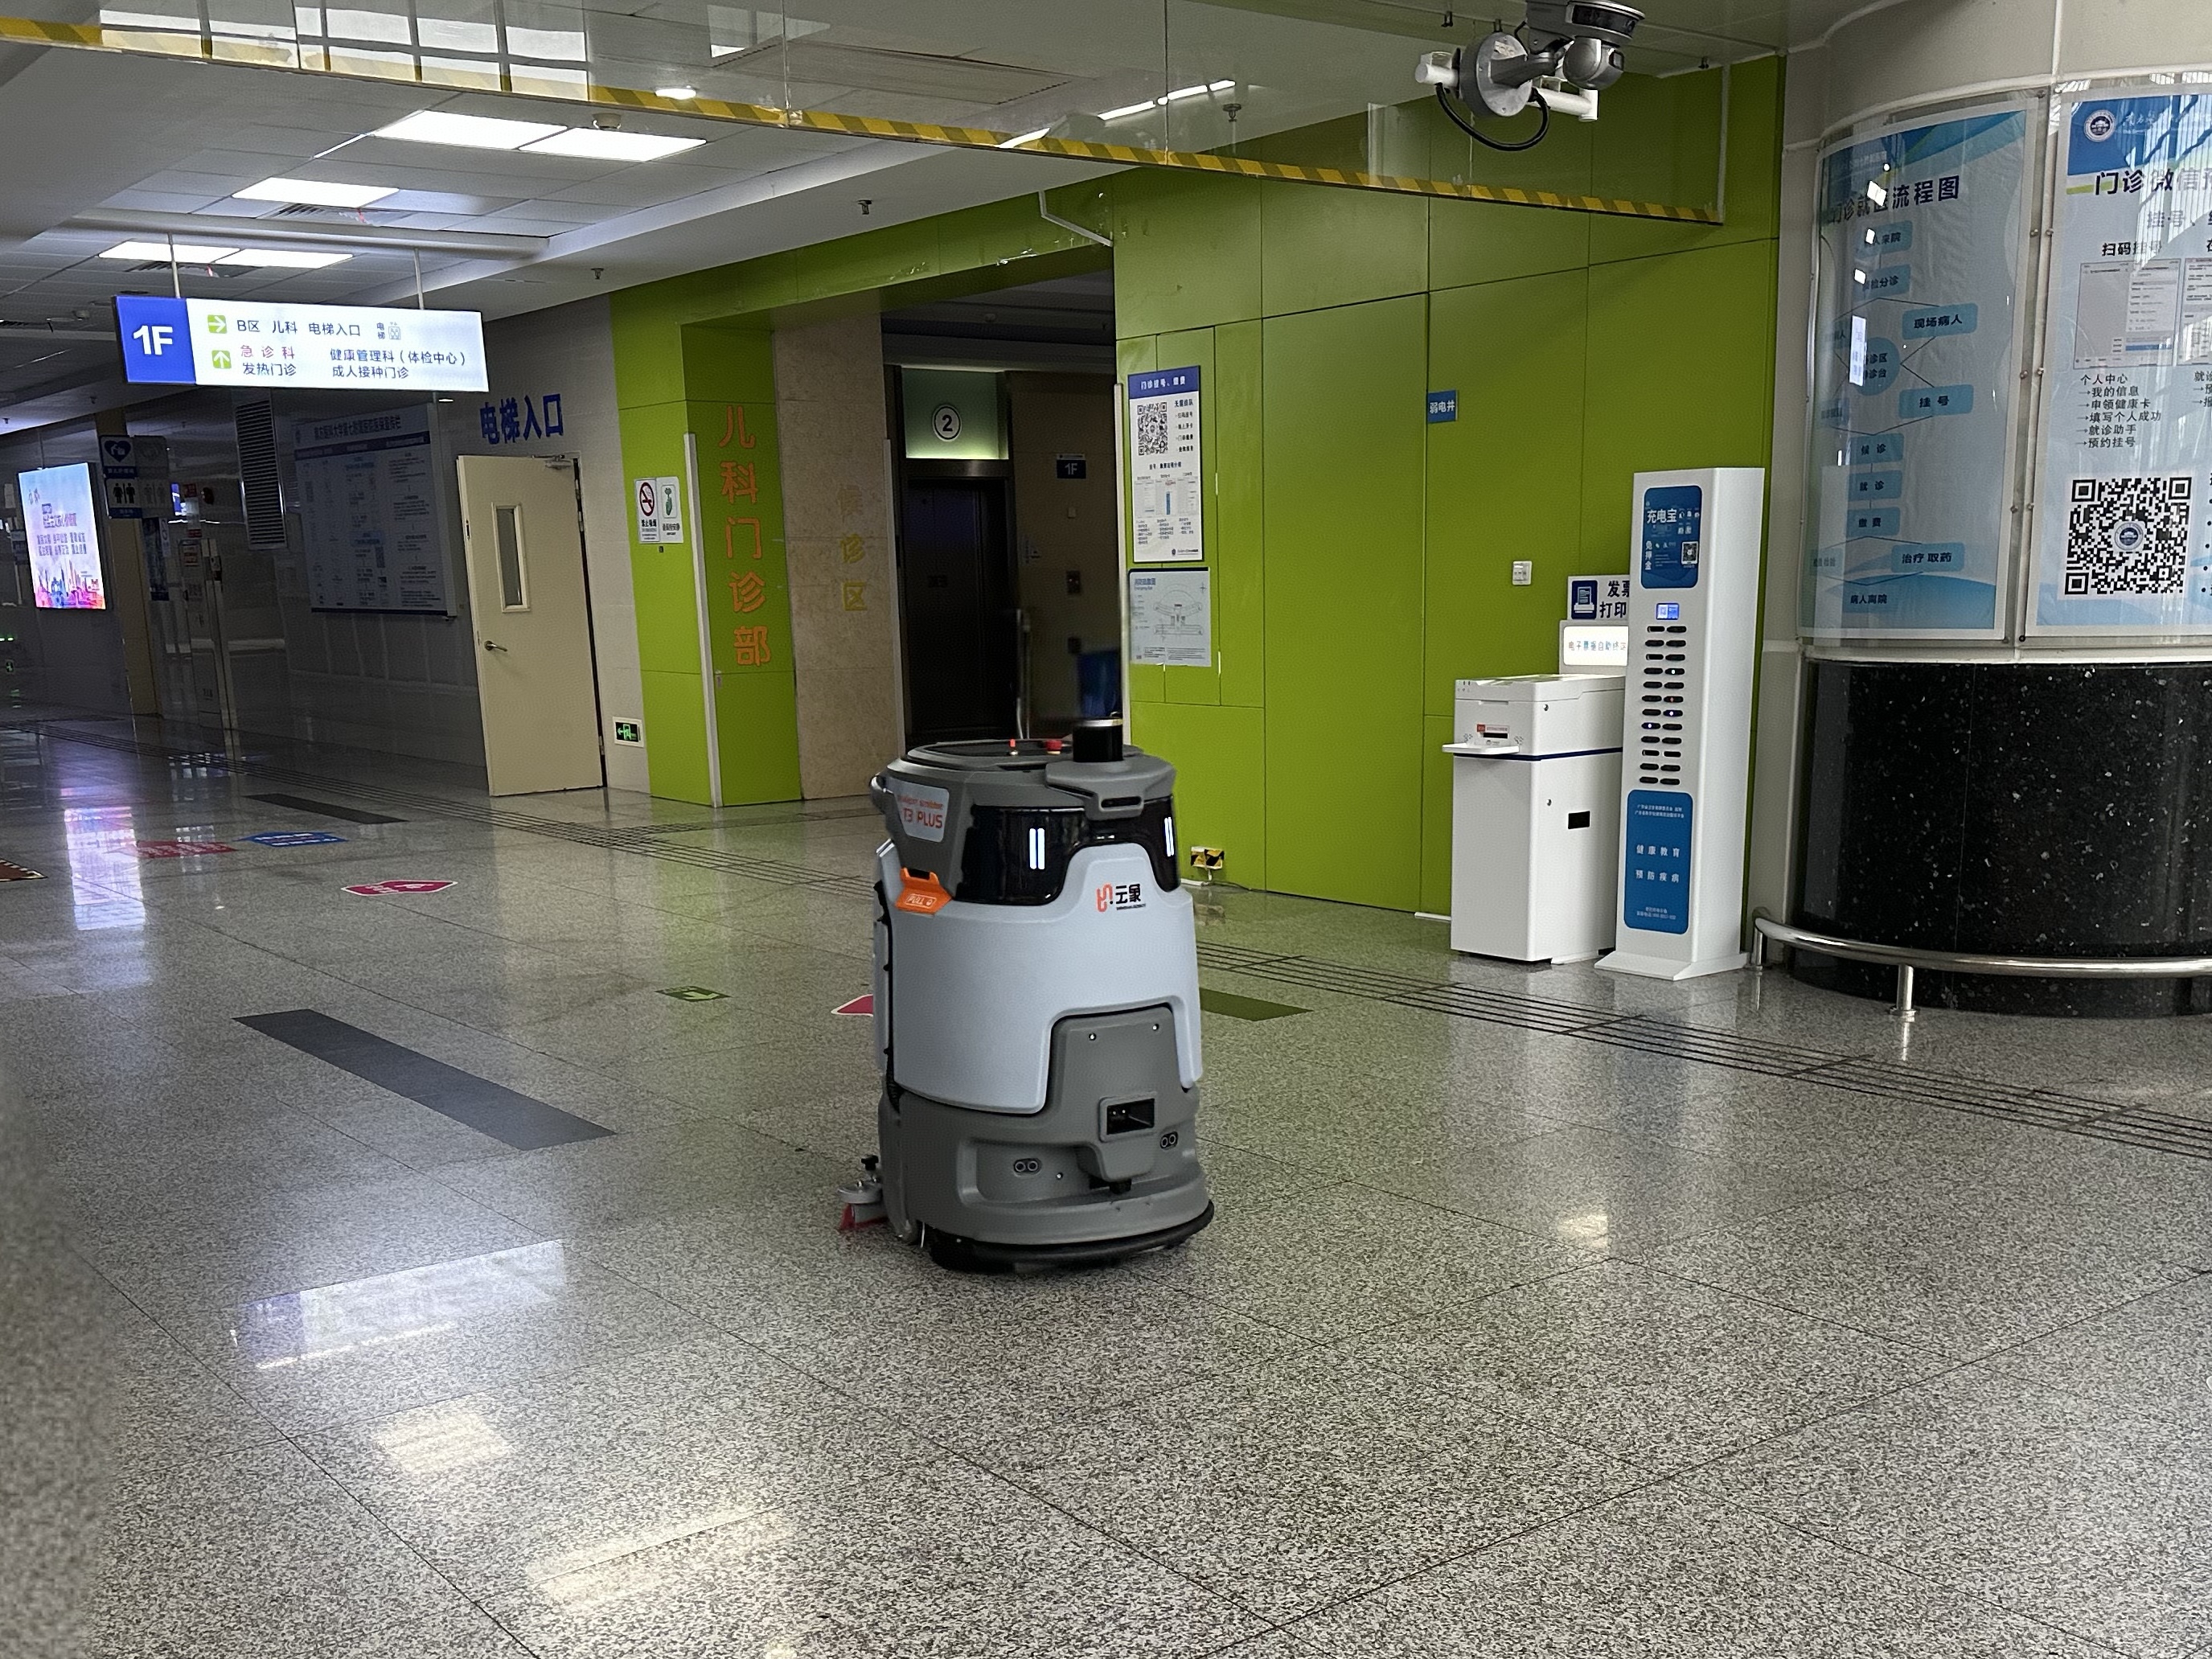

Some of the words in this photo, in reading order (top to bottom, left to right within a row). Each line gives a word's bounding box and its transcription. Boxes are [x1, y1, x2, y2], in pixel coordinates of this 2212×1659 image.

[237, 320, 260, 332] B区
[273, 321, 298, 334] 儿科
[309, 322, 361, 336] 电梯入口
[1914, 314, 1962, 329] 现场病人
[133, 326, 174, 355] 1F
[240, 345, 295, 359] 急诊科
[1865, 353, 1888, 365] 诊区
[243, 363, 297, 376] 发热门诊
[333, 365, 408, 379] 成人接种门诊
[2080, 373, 2128, 385] 个人中心
[2091, 386, 2140, 397] 我的信息
[1430, 400, 1455, 414] 弱电井
[1919, 396, 1949, 408] 挂号
[2091, 398, 2151, 409] 申领健康卡
[480, 393, 564, 445] 电梯入口
[942, 414, 954, 432] 2
[2089, 411, 2161, 423] 填写个人成功
[2088, 424, 2136, 436] 就诊助手
[2088, 437, 2136, 448] 预约挂号
[1065, 463, 1077, 475] 1F
[1647, 508, 1677, 524] 充电宝
[719, 406, 770, 667] 儿科门诊部
[1902, 553, 1924, 564] 治疗
[1927, 552, 1952, 563] 取药
[1599, 602, 1627, 618] 打印
[917, 811, 943, 829] PLUS
[1636, 845, 1680, 857] 健康教育
[1635, 869, 1680, 883] 预防疾病
